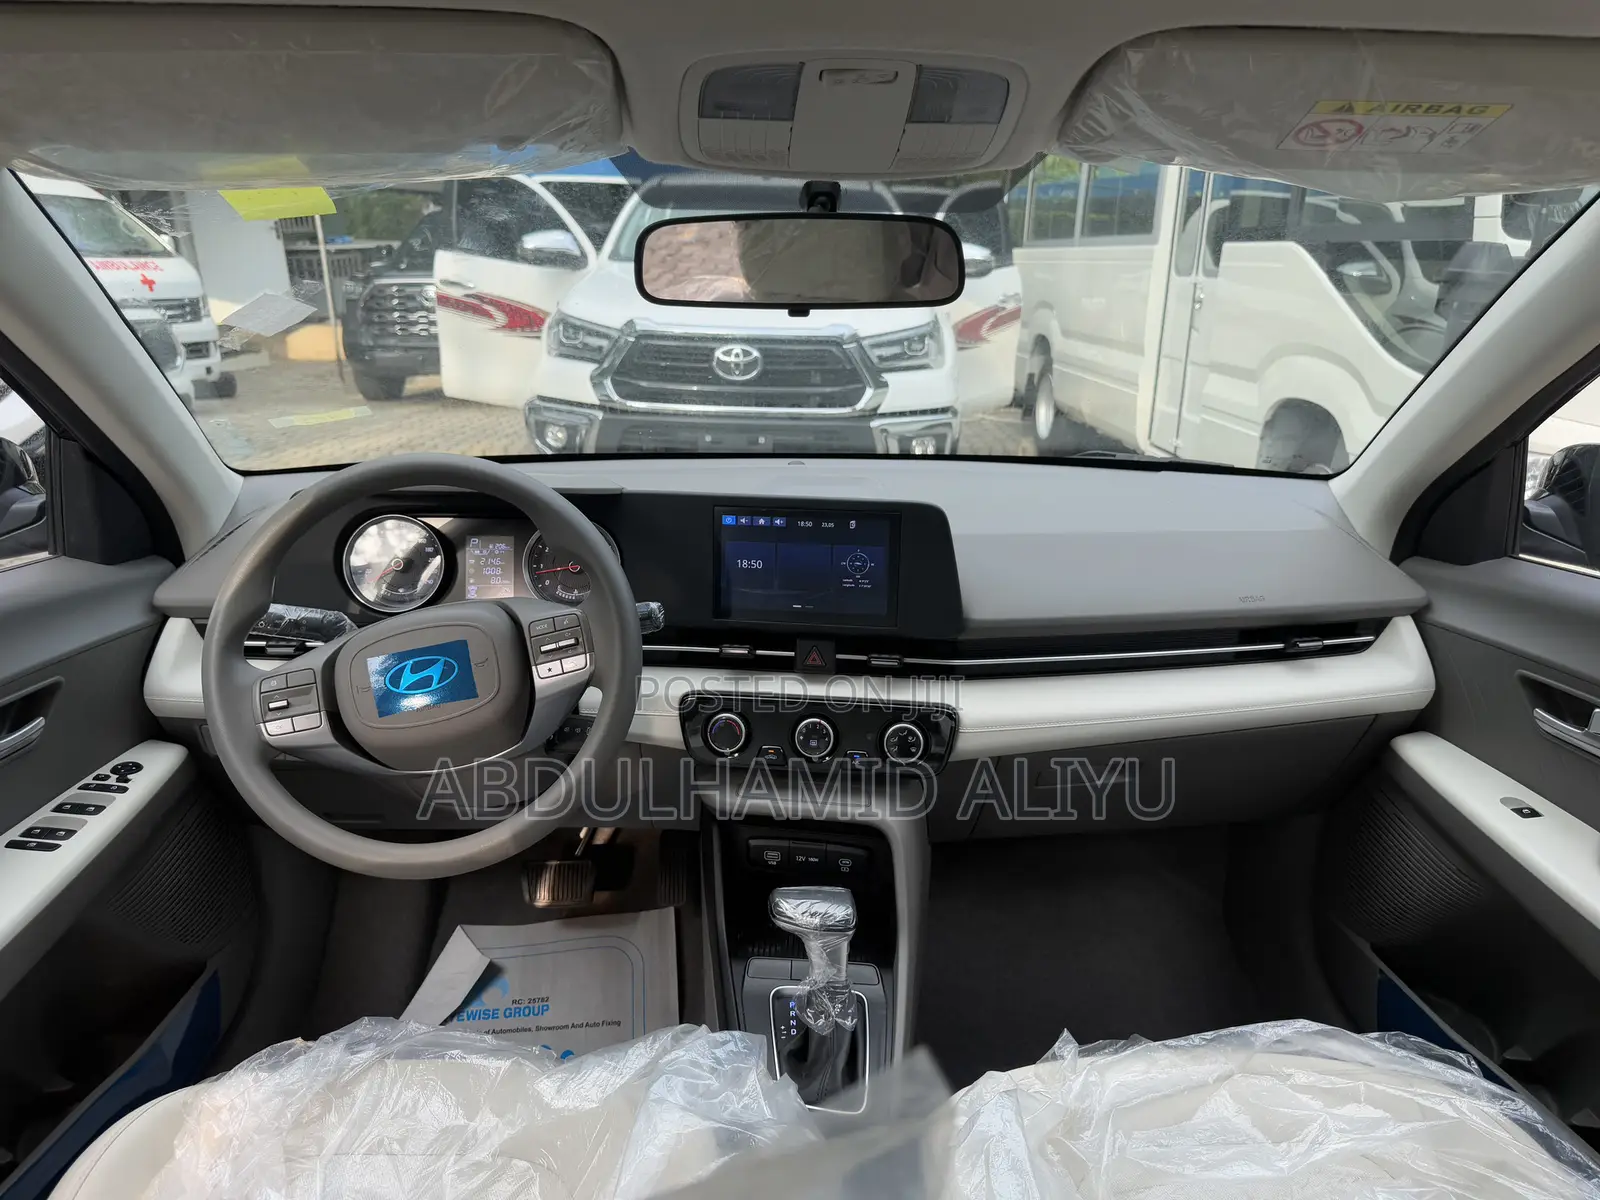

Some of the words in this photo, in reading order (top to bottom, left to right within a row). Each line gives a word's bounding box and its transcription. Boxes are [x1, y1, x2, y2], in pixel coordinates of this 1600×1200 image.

[1368, 103, 1491, 115] AIRBAG
[797, 520, 813, 528] 18:50
[470, 538, 479, 548] P
[736, 559, 763, 569] 18:50
[503, 1003, 550, 1019] GROUP
[491, 1026, 533, 1035] Automobiles,
[535, 1023, 570, 1032] Showroom
[601, 1019, 622, 1027] Fixing
